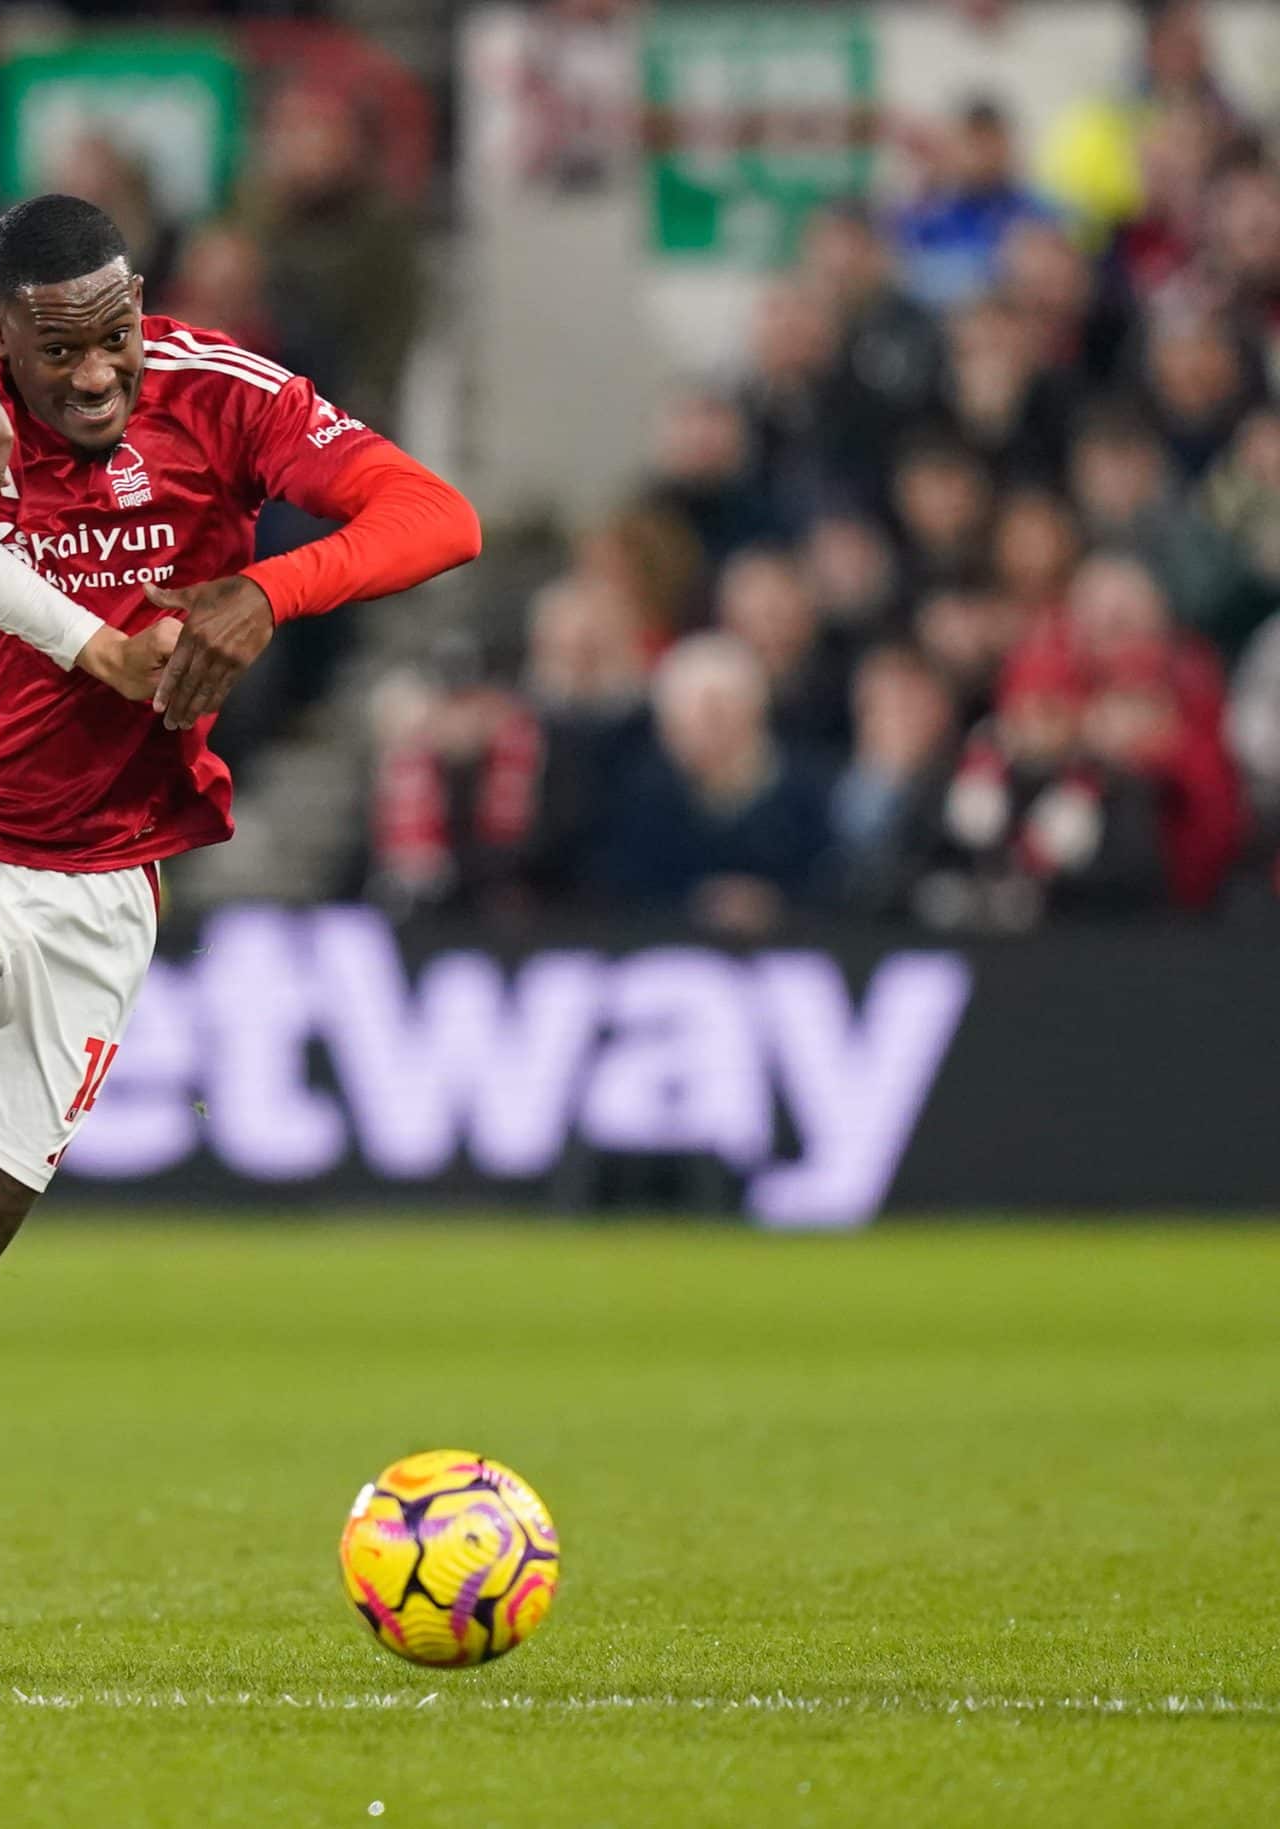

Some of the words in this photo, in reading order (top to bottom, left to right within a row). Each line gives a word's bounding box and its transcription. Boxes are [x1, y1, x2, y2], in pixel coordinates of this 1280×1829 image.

[118, 487, 152, 509] FOREST
[31, 523, 175, 561] kaiyun
[62, 904, 972, 1229] etway
